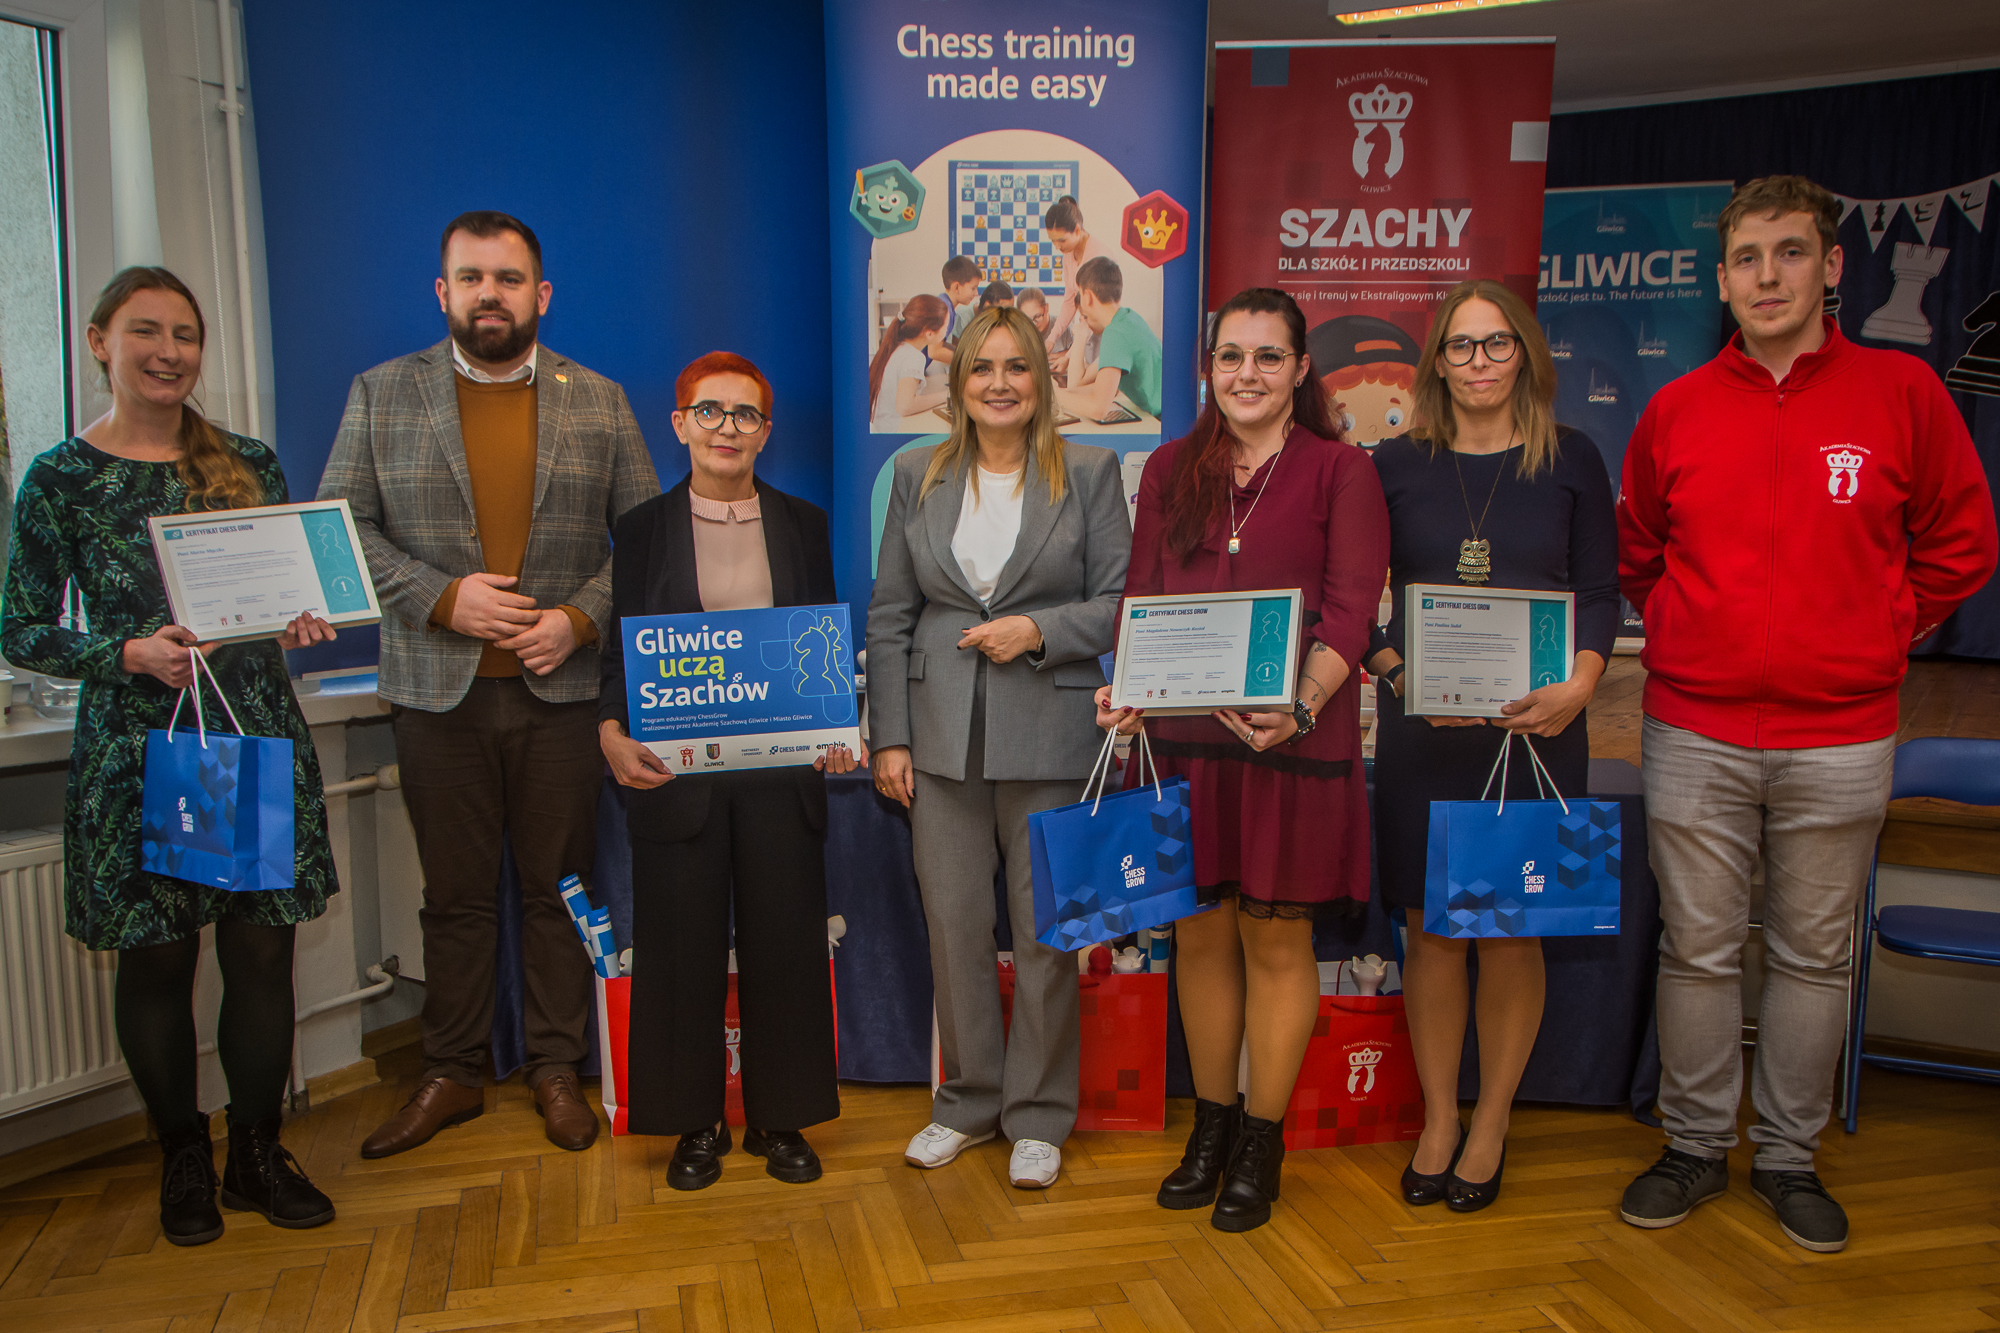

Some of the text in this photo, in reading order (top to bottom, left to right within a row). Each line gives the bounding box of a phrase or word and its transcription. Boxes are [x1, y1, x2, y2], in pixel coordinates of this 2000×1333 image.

[897, 24, 1135, 67] Chess training
[927, 67, 1107, 106] made easy
[1360, 184, 1392, 194] GLIWICE
[1280, 208, 1472, 248] SZACHY
[1692, 220, 1718, 229] Gliwic
[1278, 255, 1470, 270] DLA SZKÓŁ I PRZEDSZKOLI
[1297, 290, 1311, 302] się
[1319, 291, 1348, 302] trenuj
[1361, 290, 1434, 302] Ekstraligowym
[1538, 288, 1702, 303] szłość jest tu. The future is here
[185, 528, 218, 537] CERTYFIKAT
[340, 581, 347, 592] 1
[636, 625, 743, 655] Gliwice
[659, 655, 726, 680] uczą
[1265, 666, 1269, 677] 1
[640, 673, 769, 709] Szachów
[1124, 867, 1146, 880] CHESS
[1524, 875, 1545, 884] CHESS
[1126, 876, 1145, 888] GROW
[1524, 885, 1544, 893] GROW
